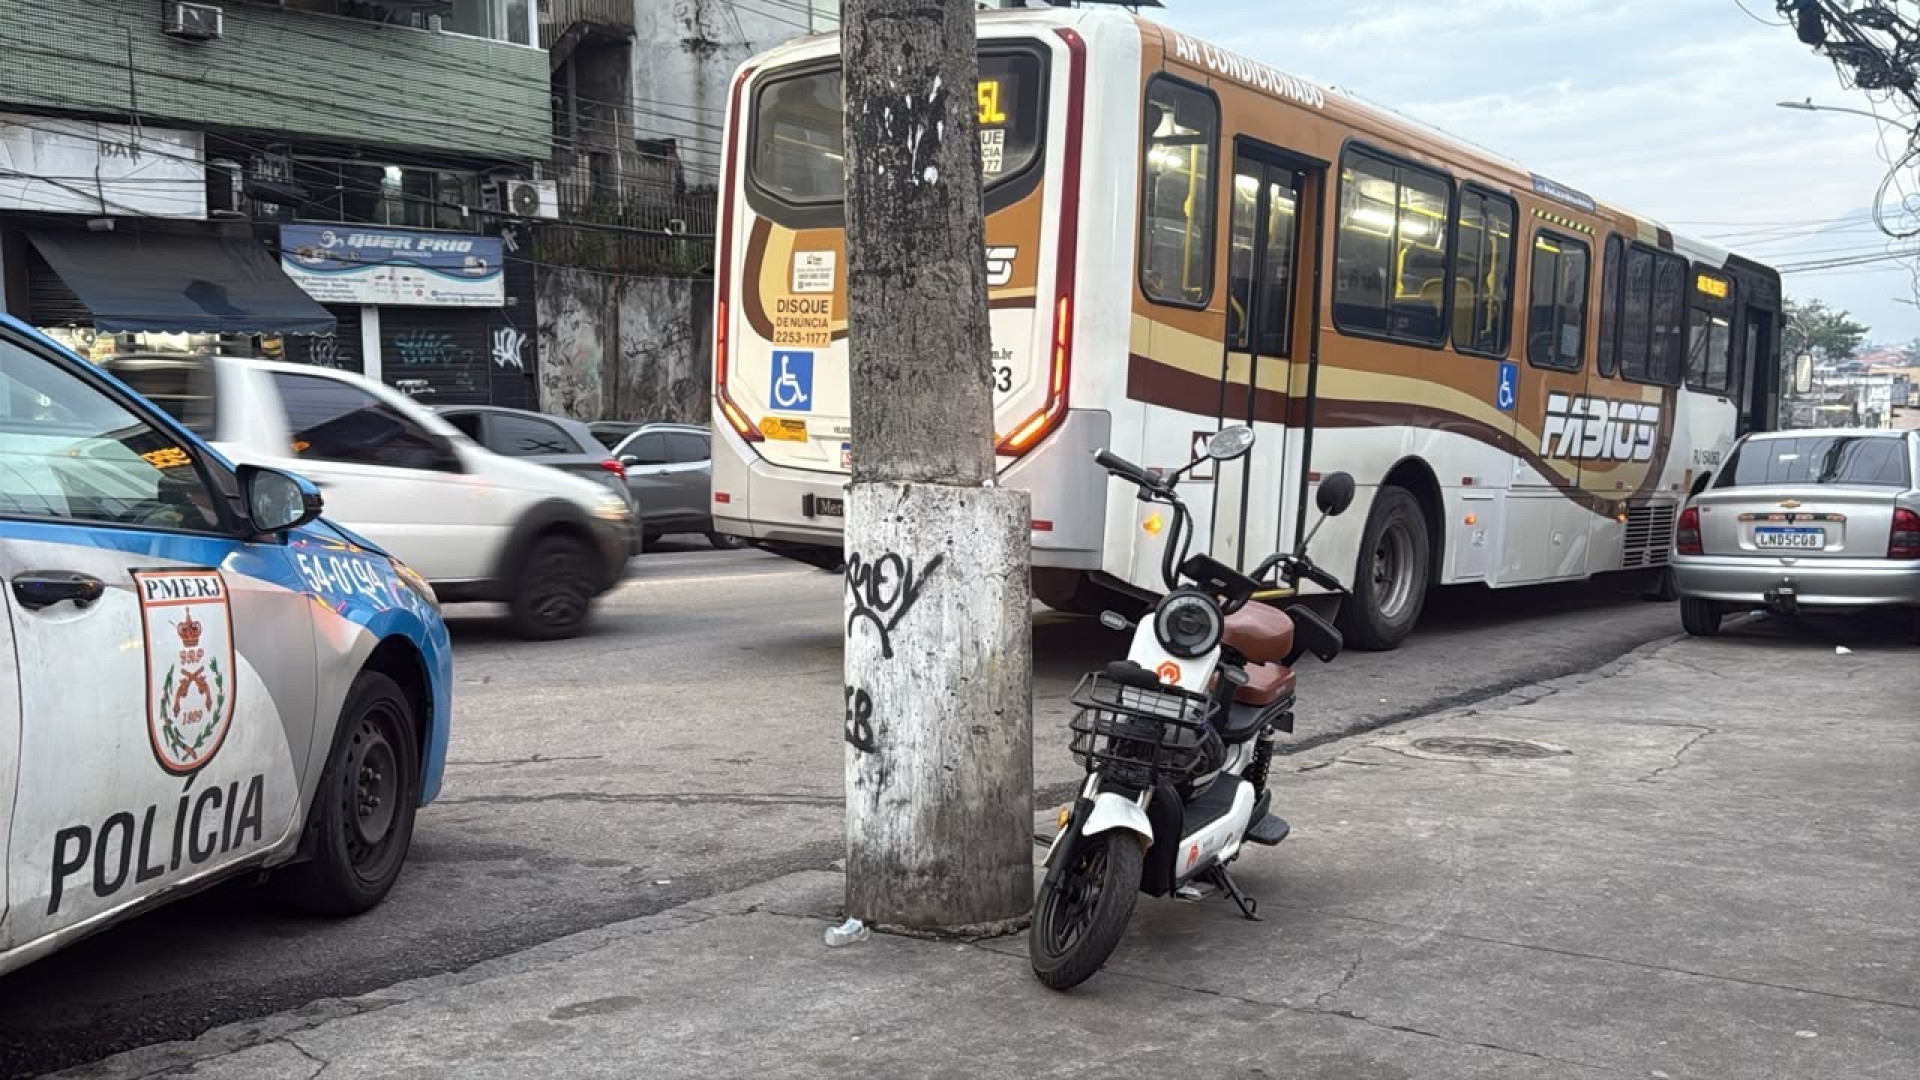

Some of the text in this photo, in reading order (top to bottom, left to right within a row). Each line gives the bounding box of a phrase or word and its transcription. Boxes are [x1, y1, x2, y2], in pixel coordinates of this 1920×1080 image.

[1175, 32, 1324, 109] AR CONDICIONADO
[977, 80, 1006, 123] 5L
[100, 141, 142, 159] BAR
[347, 233, 412, 250] QUER
[776, 299, 829, 314] DISQUE
[776, 331, 828, 344] 2253-1177
[820, 498, 843, 514] Mer
[144, 578, 220, 600] PMERJ
[47, 770, 265, 917] POLÍCIA
